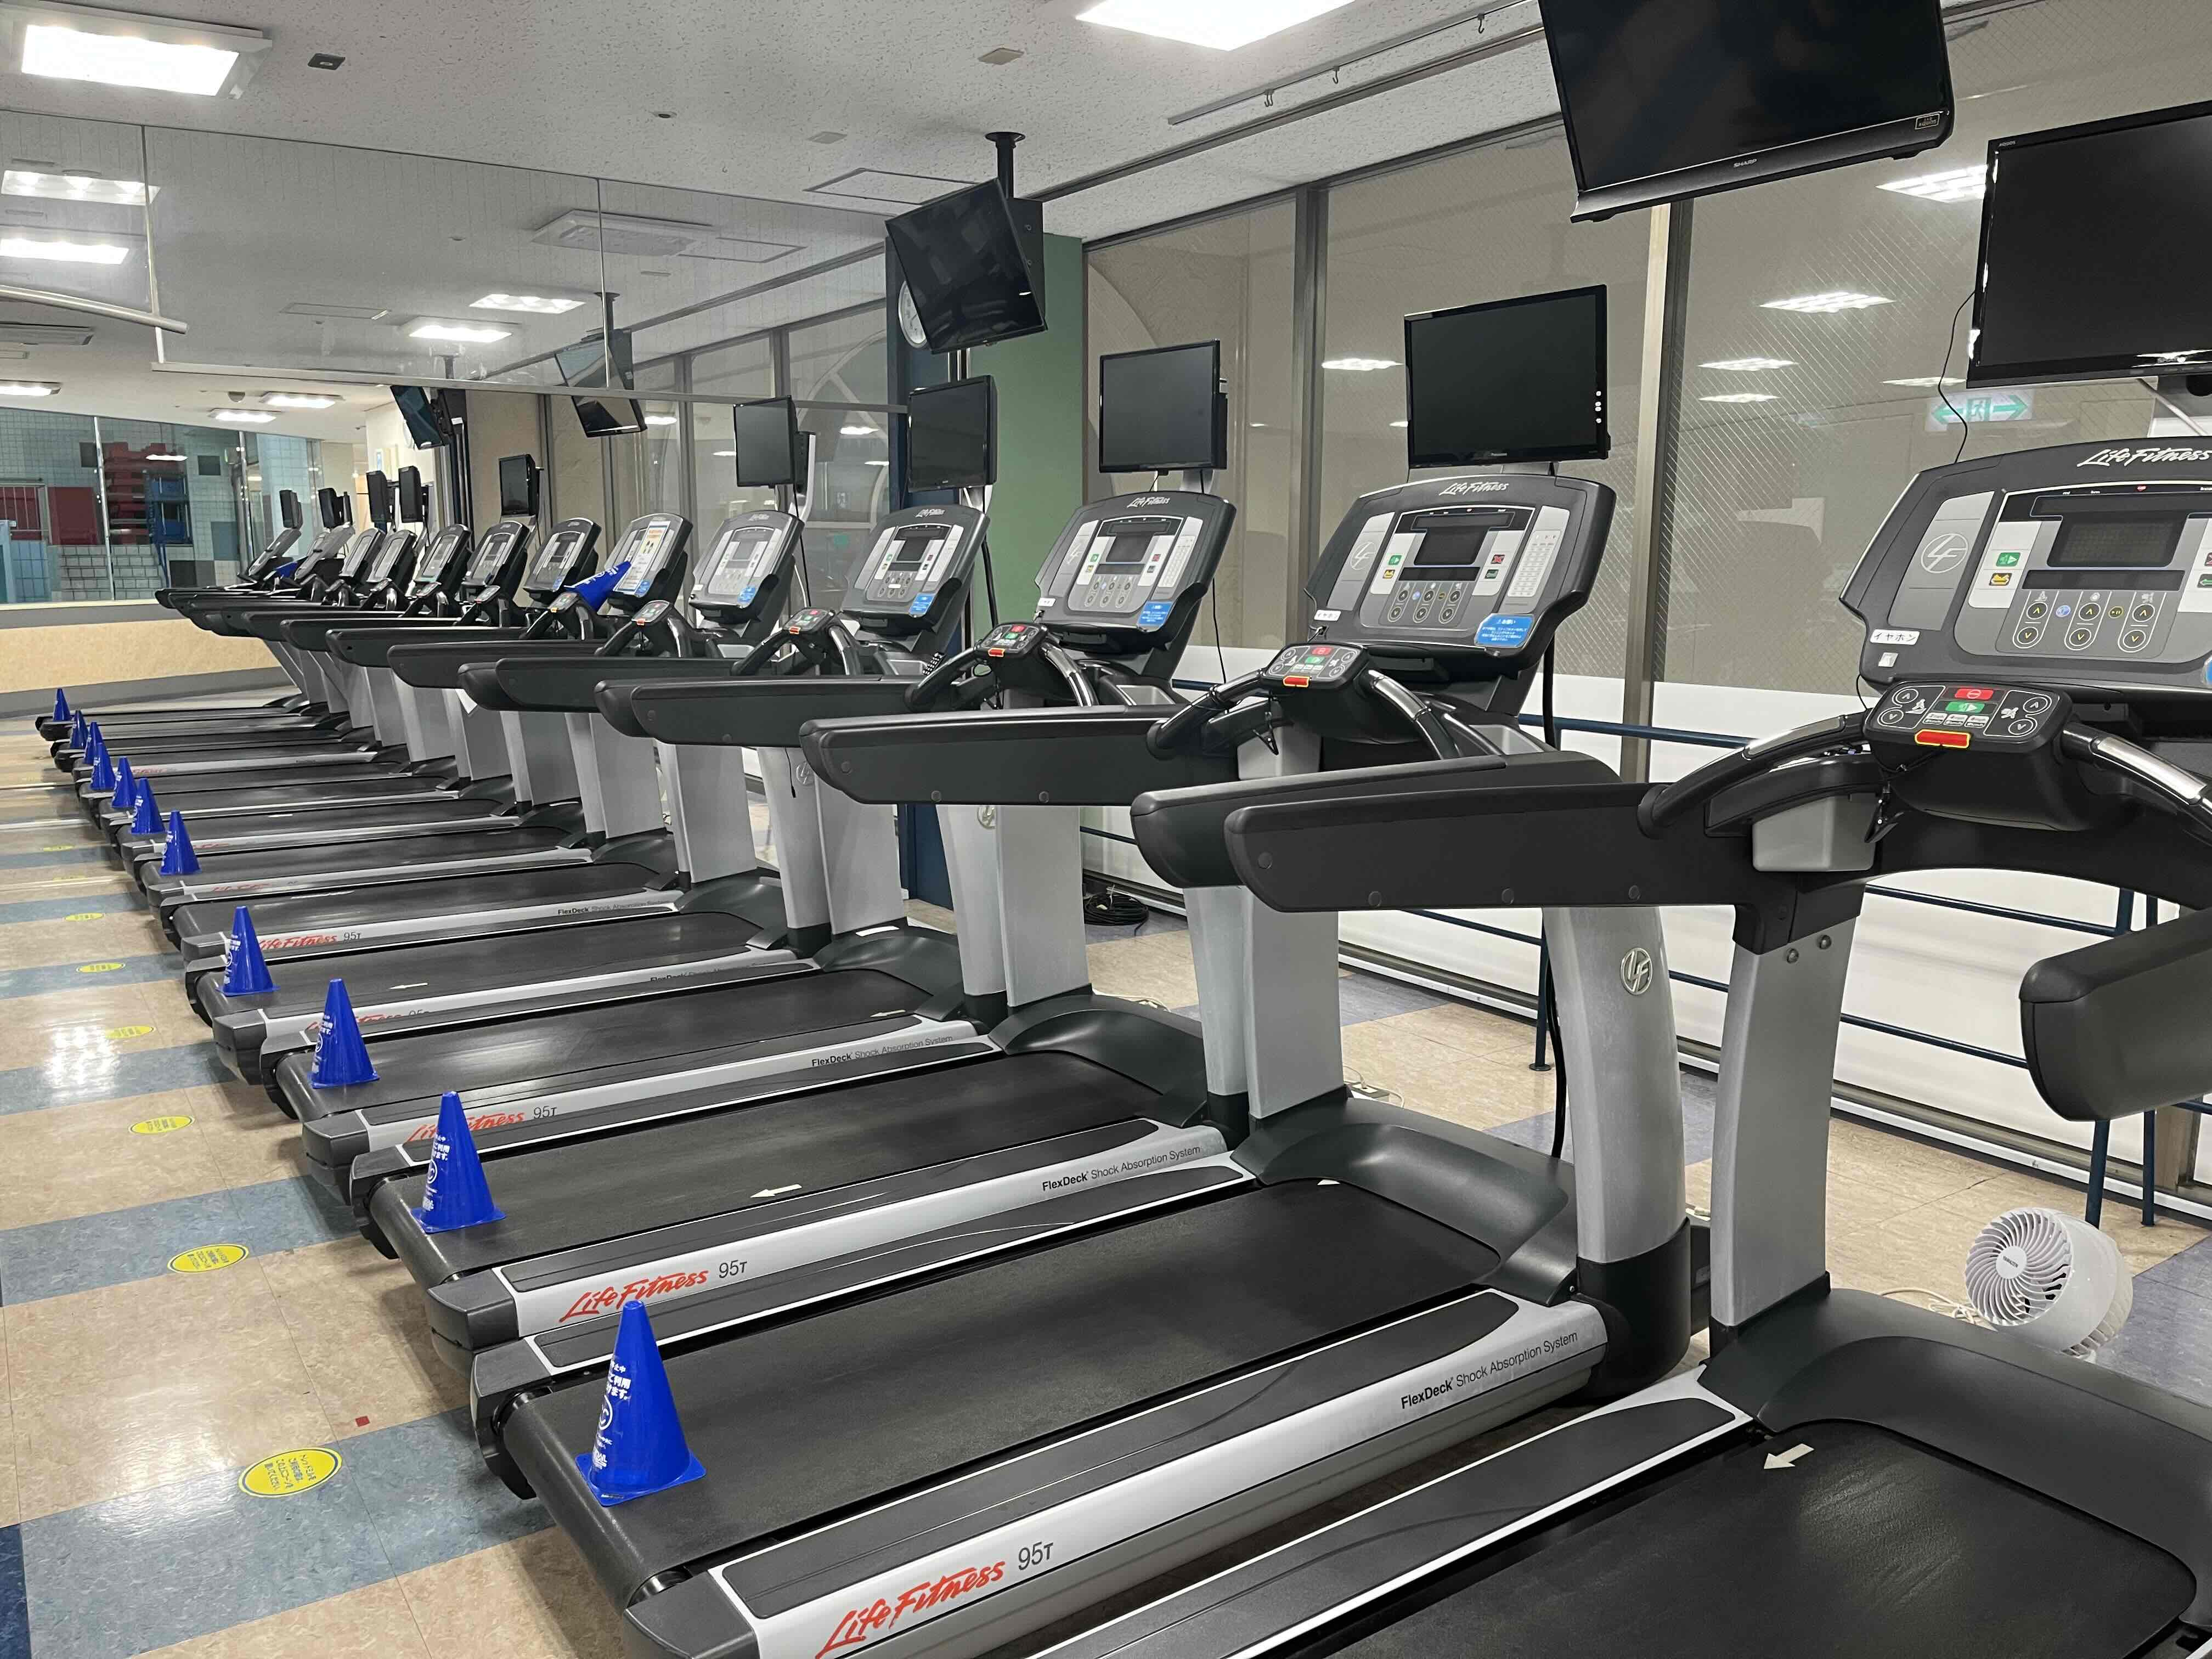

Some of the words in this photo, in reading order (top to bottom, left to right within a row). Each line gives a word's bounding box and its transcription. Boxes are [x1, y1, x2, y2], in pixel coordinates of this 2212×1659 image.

[1734, 159, 1757, 168] SHARP
[1873, 633, 1917, 643] イヤホン
[1091, 1166, 1119, 1179] Shock
[1121, 1154, 1168, 1172] Absorption
[1169, 1146, 1200, 1160] System
[1457, 1367, 1488, 1387] Shock
[1490, 1346, 1542, 1375] Absorption
[1543, 1331, 1578, 1353] System
